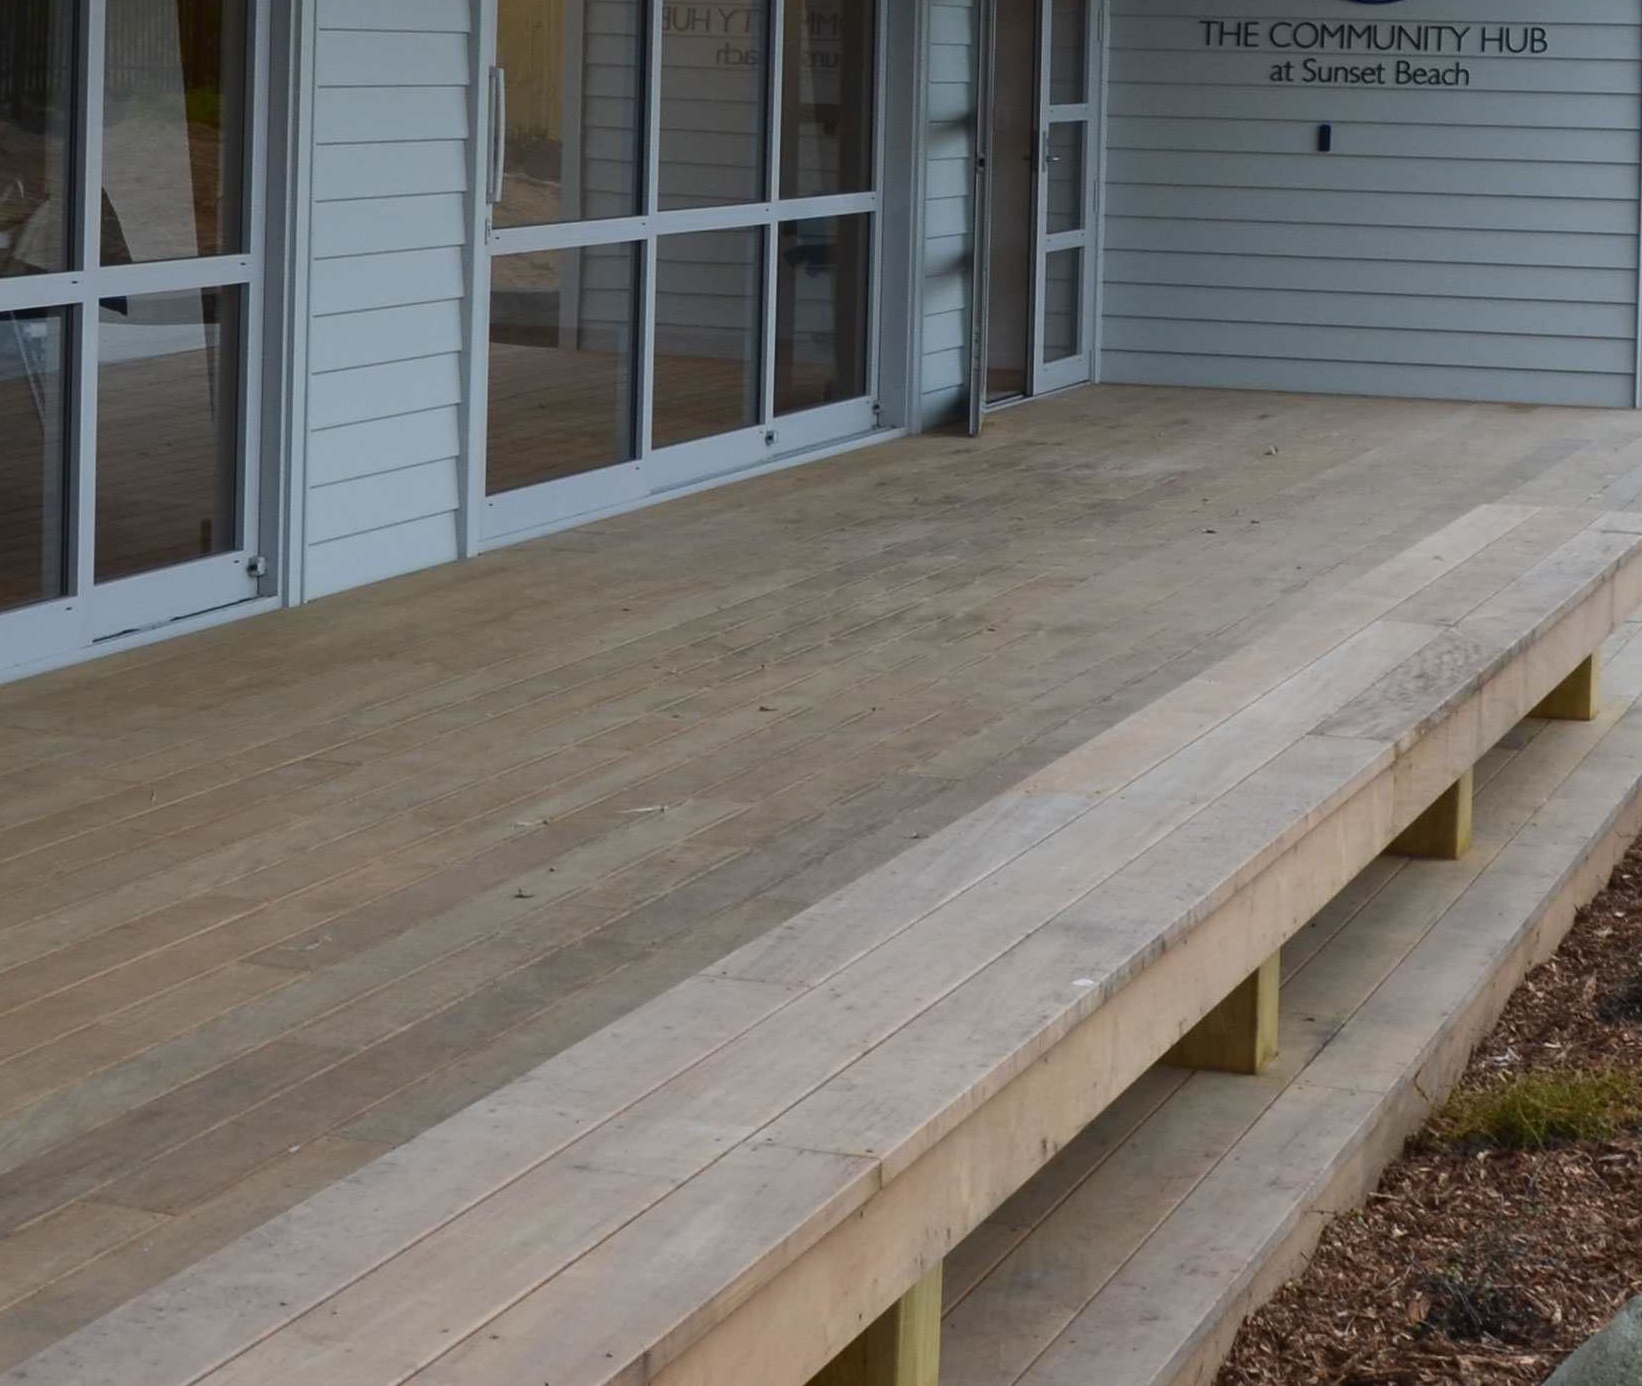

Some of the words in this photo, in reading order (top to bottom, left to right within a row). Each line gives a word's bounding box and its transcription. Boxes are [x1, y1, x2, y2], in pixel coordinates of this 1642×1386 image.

[1199, 20, 1259, 48] THE
[1269, 22, 1471, 53] COMMUNITY
[1480, 26, 1549, 54] HUB
[1269, 61, 1295, 83] at
[1302, 58, 1386, 85] Sunset
[1395, 60, 1470, 87] Beach
